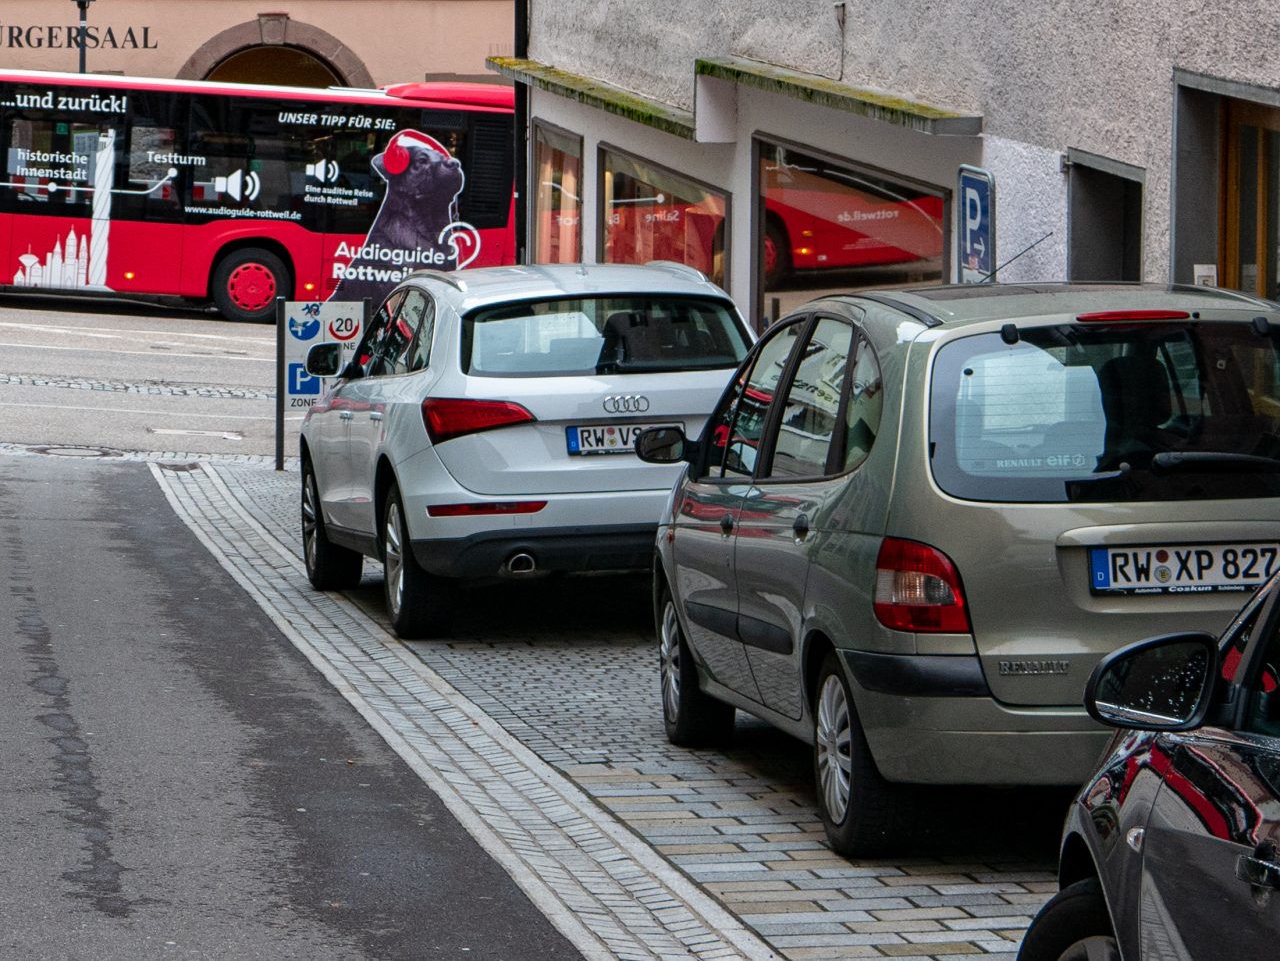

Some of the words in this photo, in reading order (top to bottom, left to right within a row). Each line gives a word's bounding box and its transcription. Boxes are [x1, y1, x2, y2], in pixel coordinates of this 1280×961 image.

[57, 93, 127, 113] zurück!
[277, 112, 318, 125] UNSER
[320, 114, 346, 127] TIPP
[348, 114, 372, 129] FÜR
[374, 118, 397, 131] SIE:
[17, 148, 88, 164] historische
[146, 150, 206, 166] Testturm
[16, 166, 87, 180] Innenstadt
[304, 194, 326, 203] durch
[326, 196, 358, 206] Rottweil
[184, 206, 302, 220] www.audioguide-rottweil.de
[965, 187, 981, 254] P
[334, 241, 445, 265] Audioguide
[335, 317, 354, 333] 20
[580, 428, 605, 448] RW
[996, 458, 1042, 468] RENAULT
[1111, 550, 1152, 583] RW
[1174, 549, 1215, 581] XP
[1222, 547, 1278, 580] 827
[999, 661, 1069, 675] RENAULT
